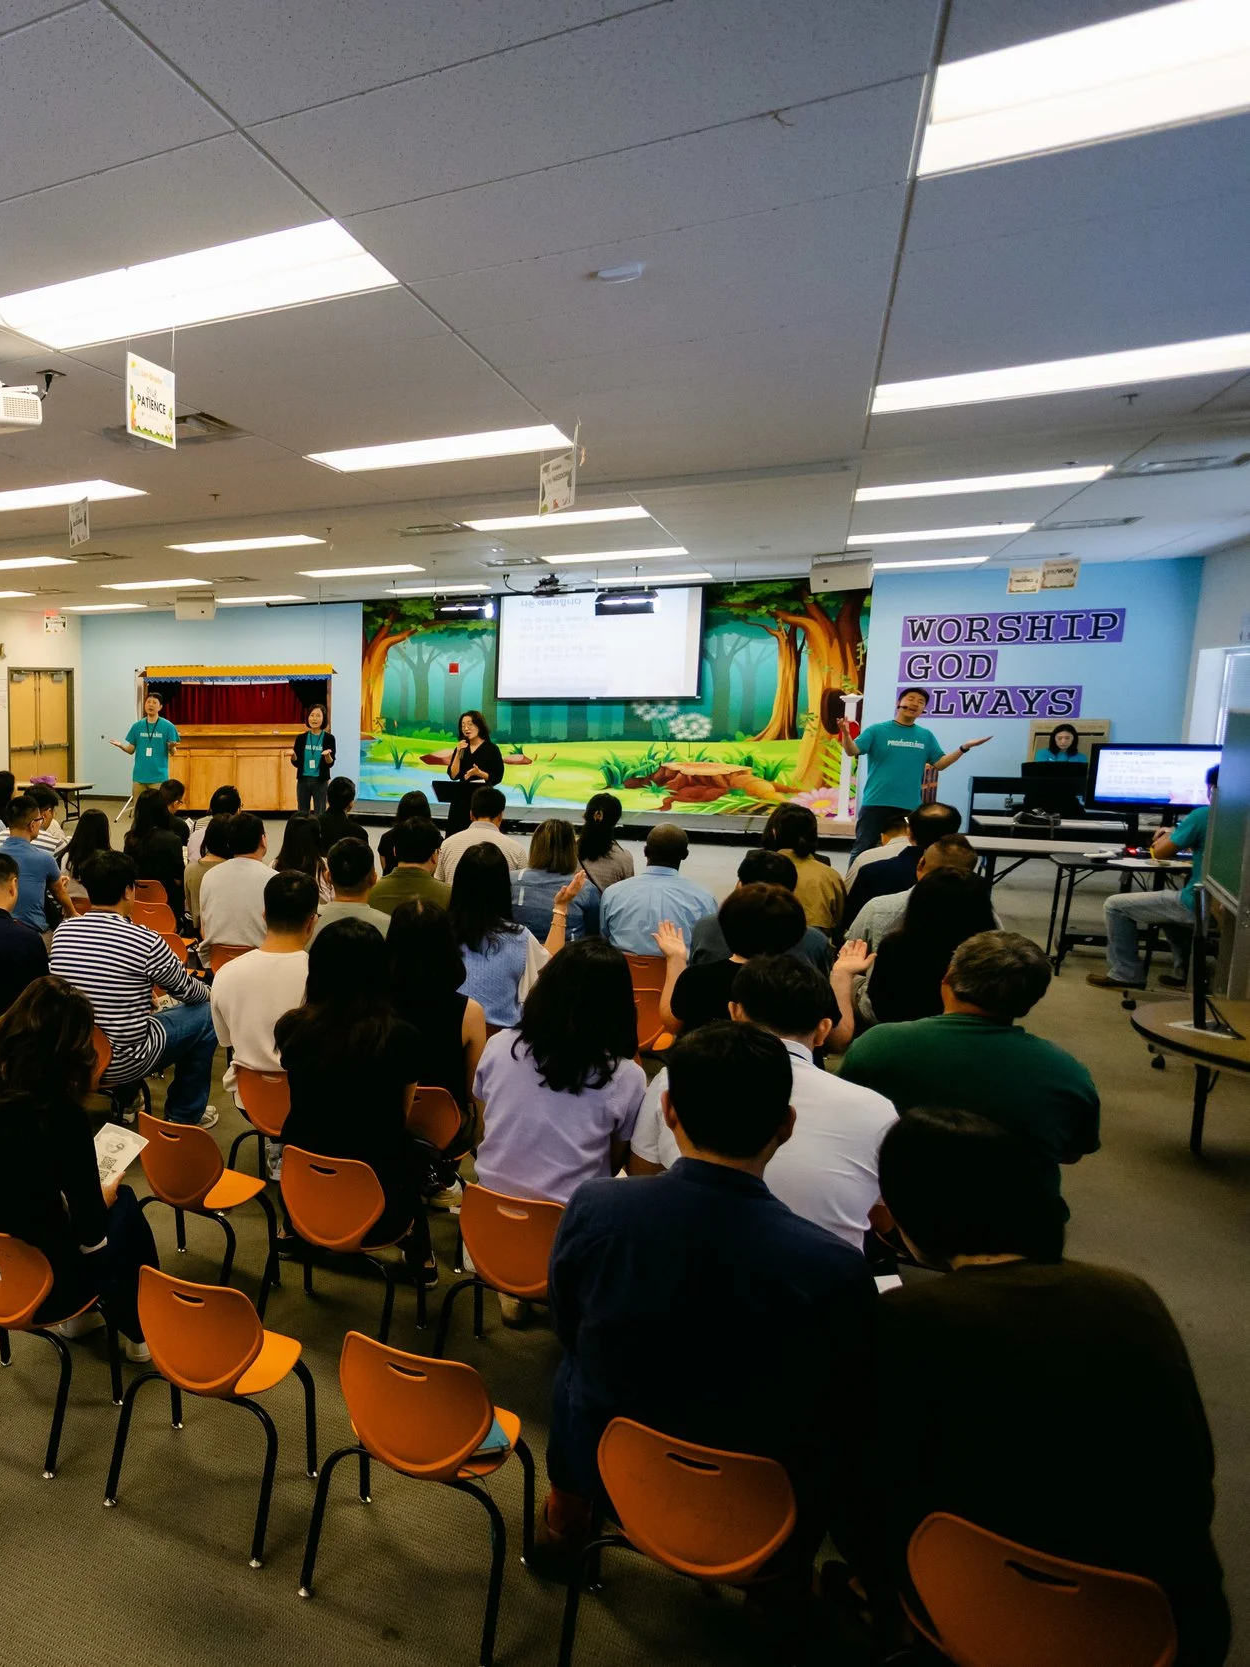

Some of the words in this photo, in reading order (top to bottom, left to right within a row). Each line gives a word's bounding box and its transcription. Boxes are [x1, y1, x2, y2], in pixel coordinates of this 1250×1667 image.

[137, 394, 166, 415] PATIENCE
[906, 612, 1119, 645] WORSHIP
[906, 653, 993, 681] GOD
[921, 688, 1076, 717] LWAYS
